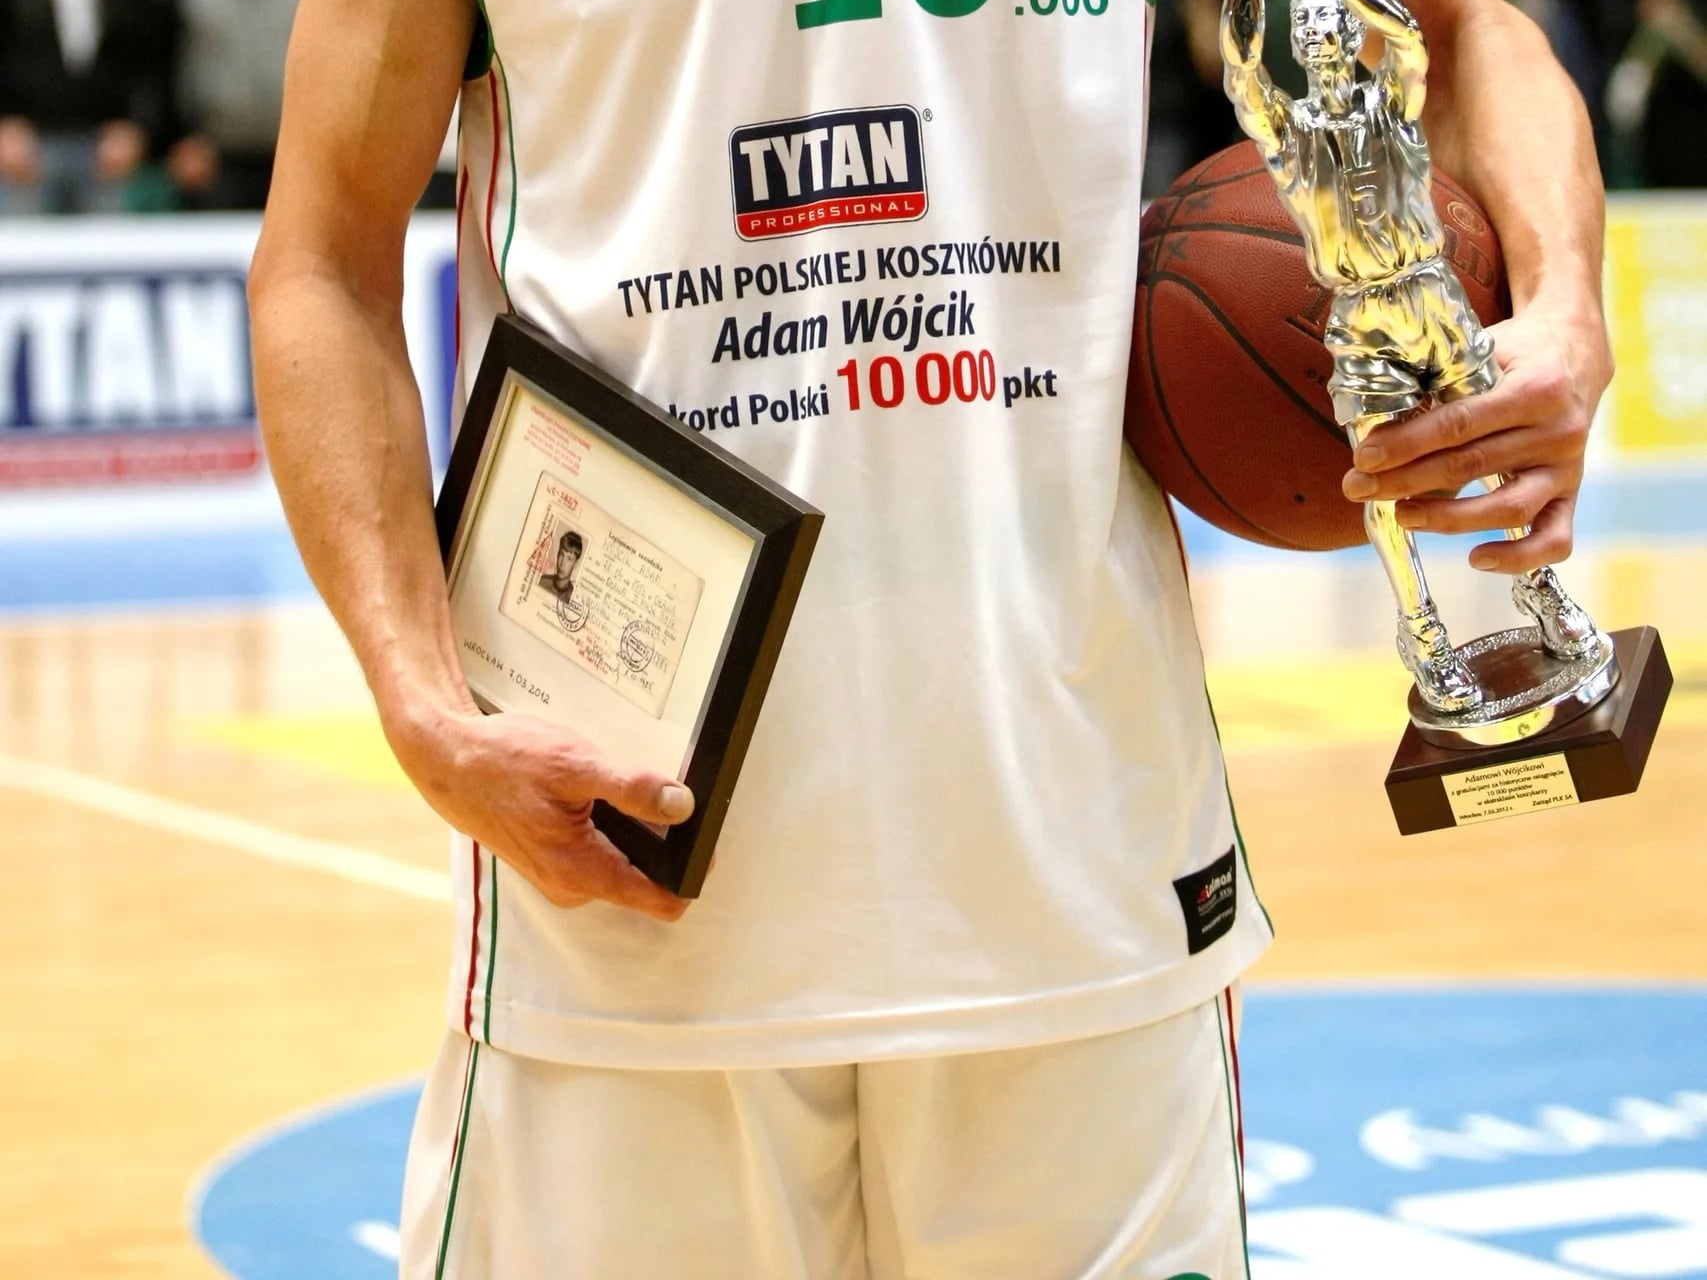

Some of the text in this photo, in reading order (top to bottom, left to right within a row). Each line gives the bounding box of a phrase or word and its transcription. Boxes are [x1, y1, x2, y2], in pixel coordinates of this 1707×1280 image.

[739, 120, 909, 202] TYTAN
[750, 200, 915, 231] PROFESSIONAL
[617, 235, 1061, 318] TYTAN POLSKIEJ KOSZYKÓWKI
[711, 289, 976, 364] Adam Wójcik
[748, 383, 830, 426] Polski
[1002, 366, 1058, 408] pkt
[1465, 762, 1545, 784] Adamowi Wójcikowi
